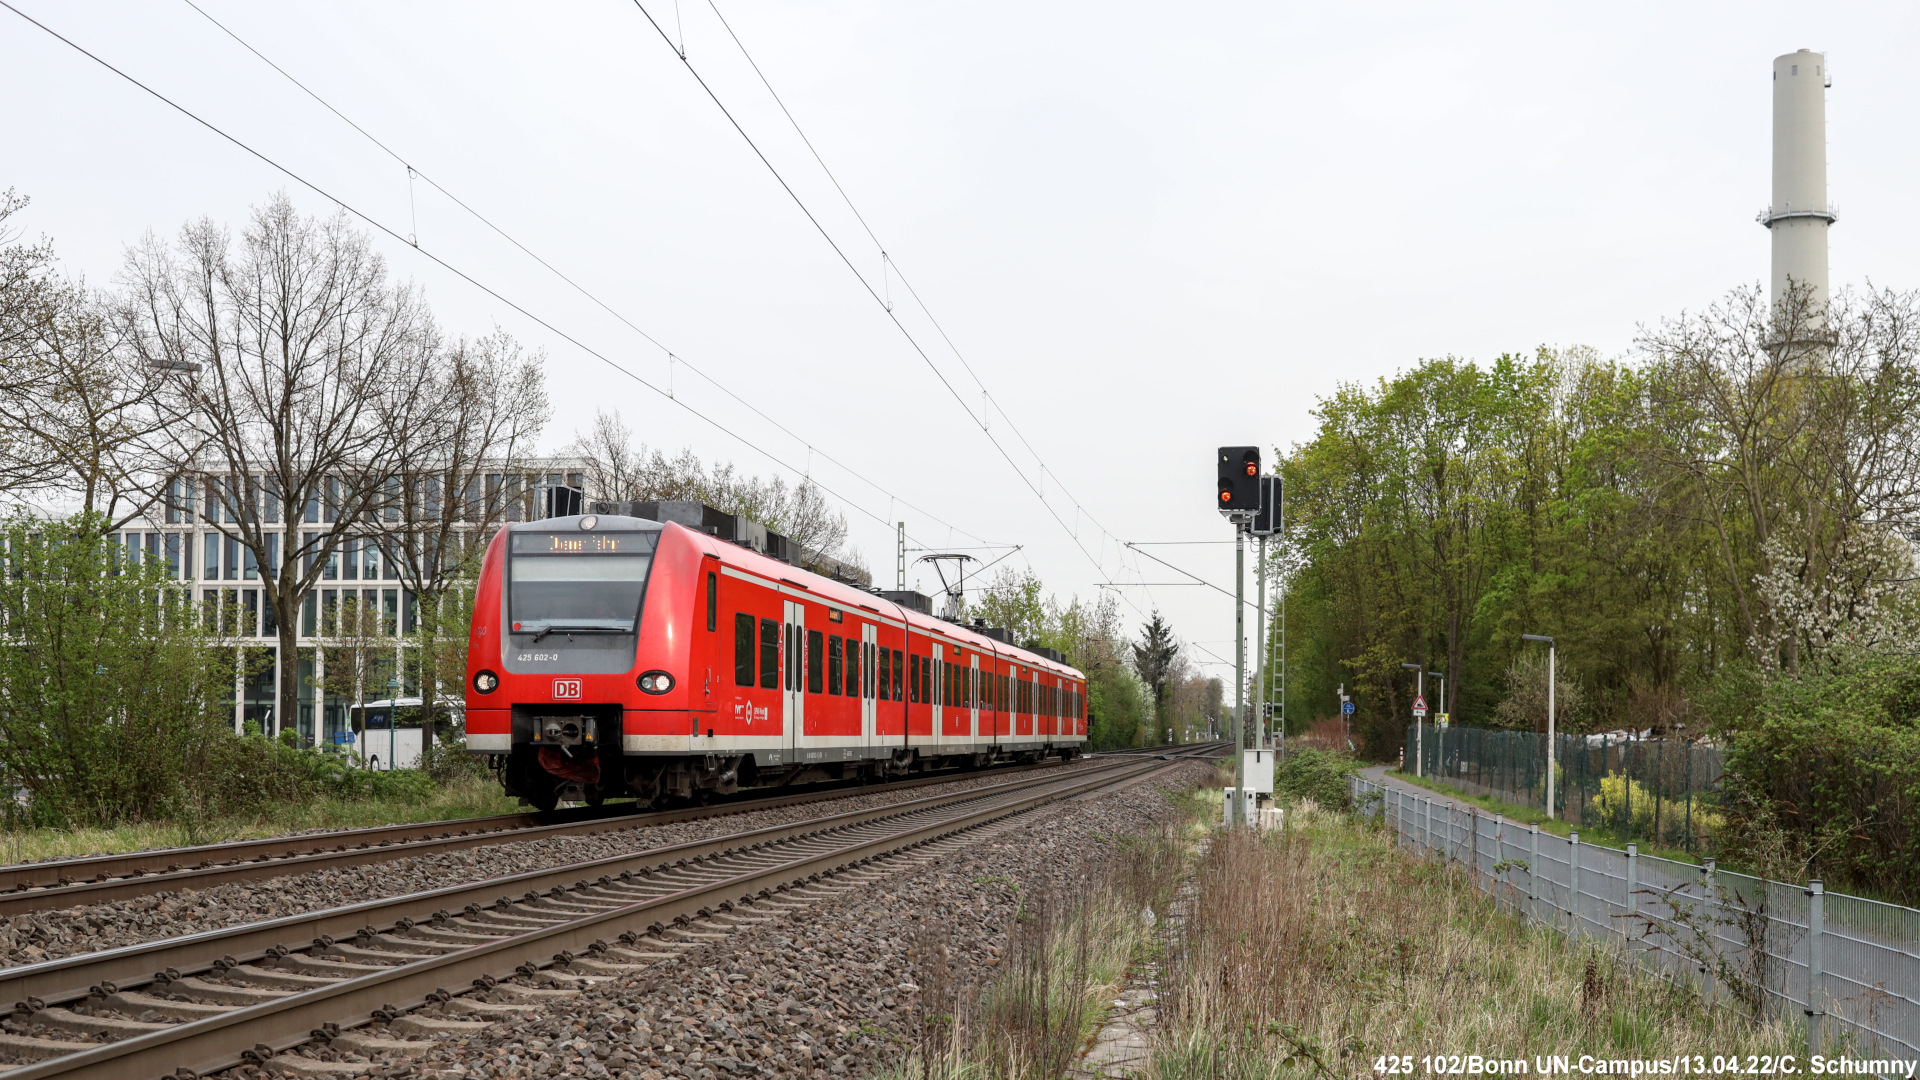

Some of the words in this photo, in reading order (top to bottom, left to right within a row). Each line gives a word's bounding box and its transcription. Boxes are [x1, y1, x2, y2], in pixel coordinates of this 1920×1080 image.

[517, 653, 532, 661] 425
[534, 653, 558, 661] 602-0
[555, 681, 580, 698] DB
